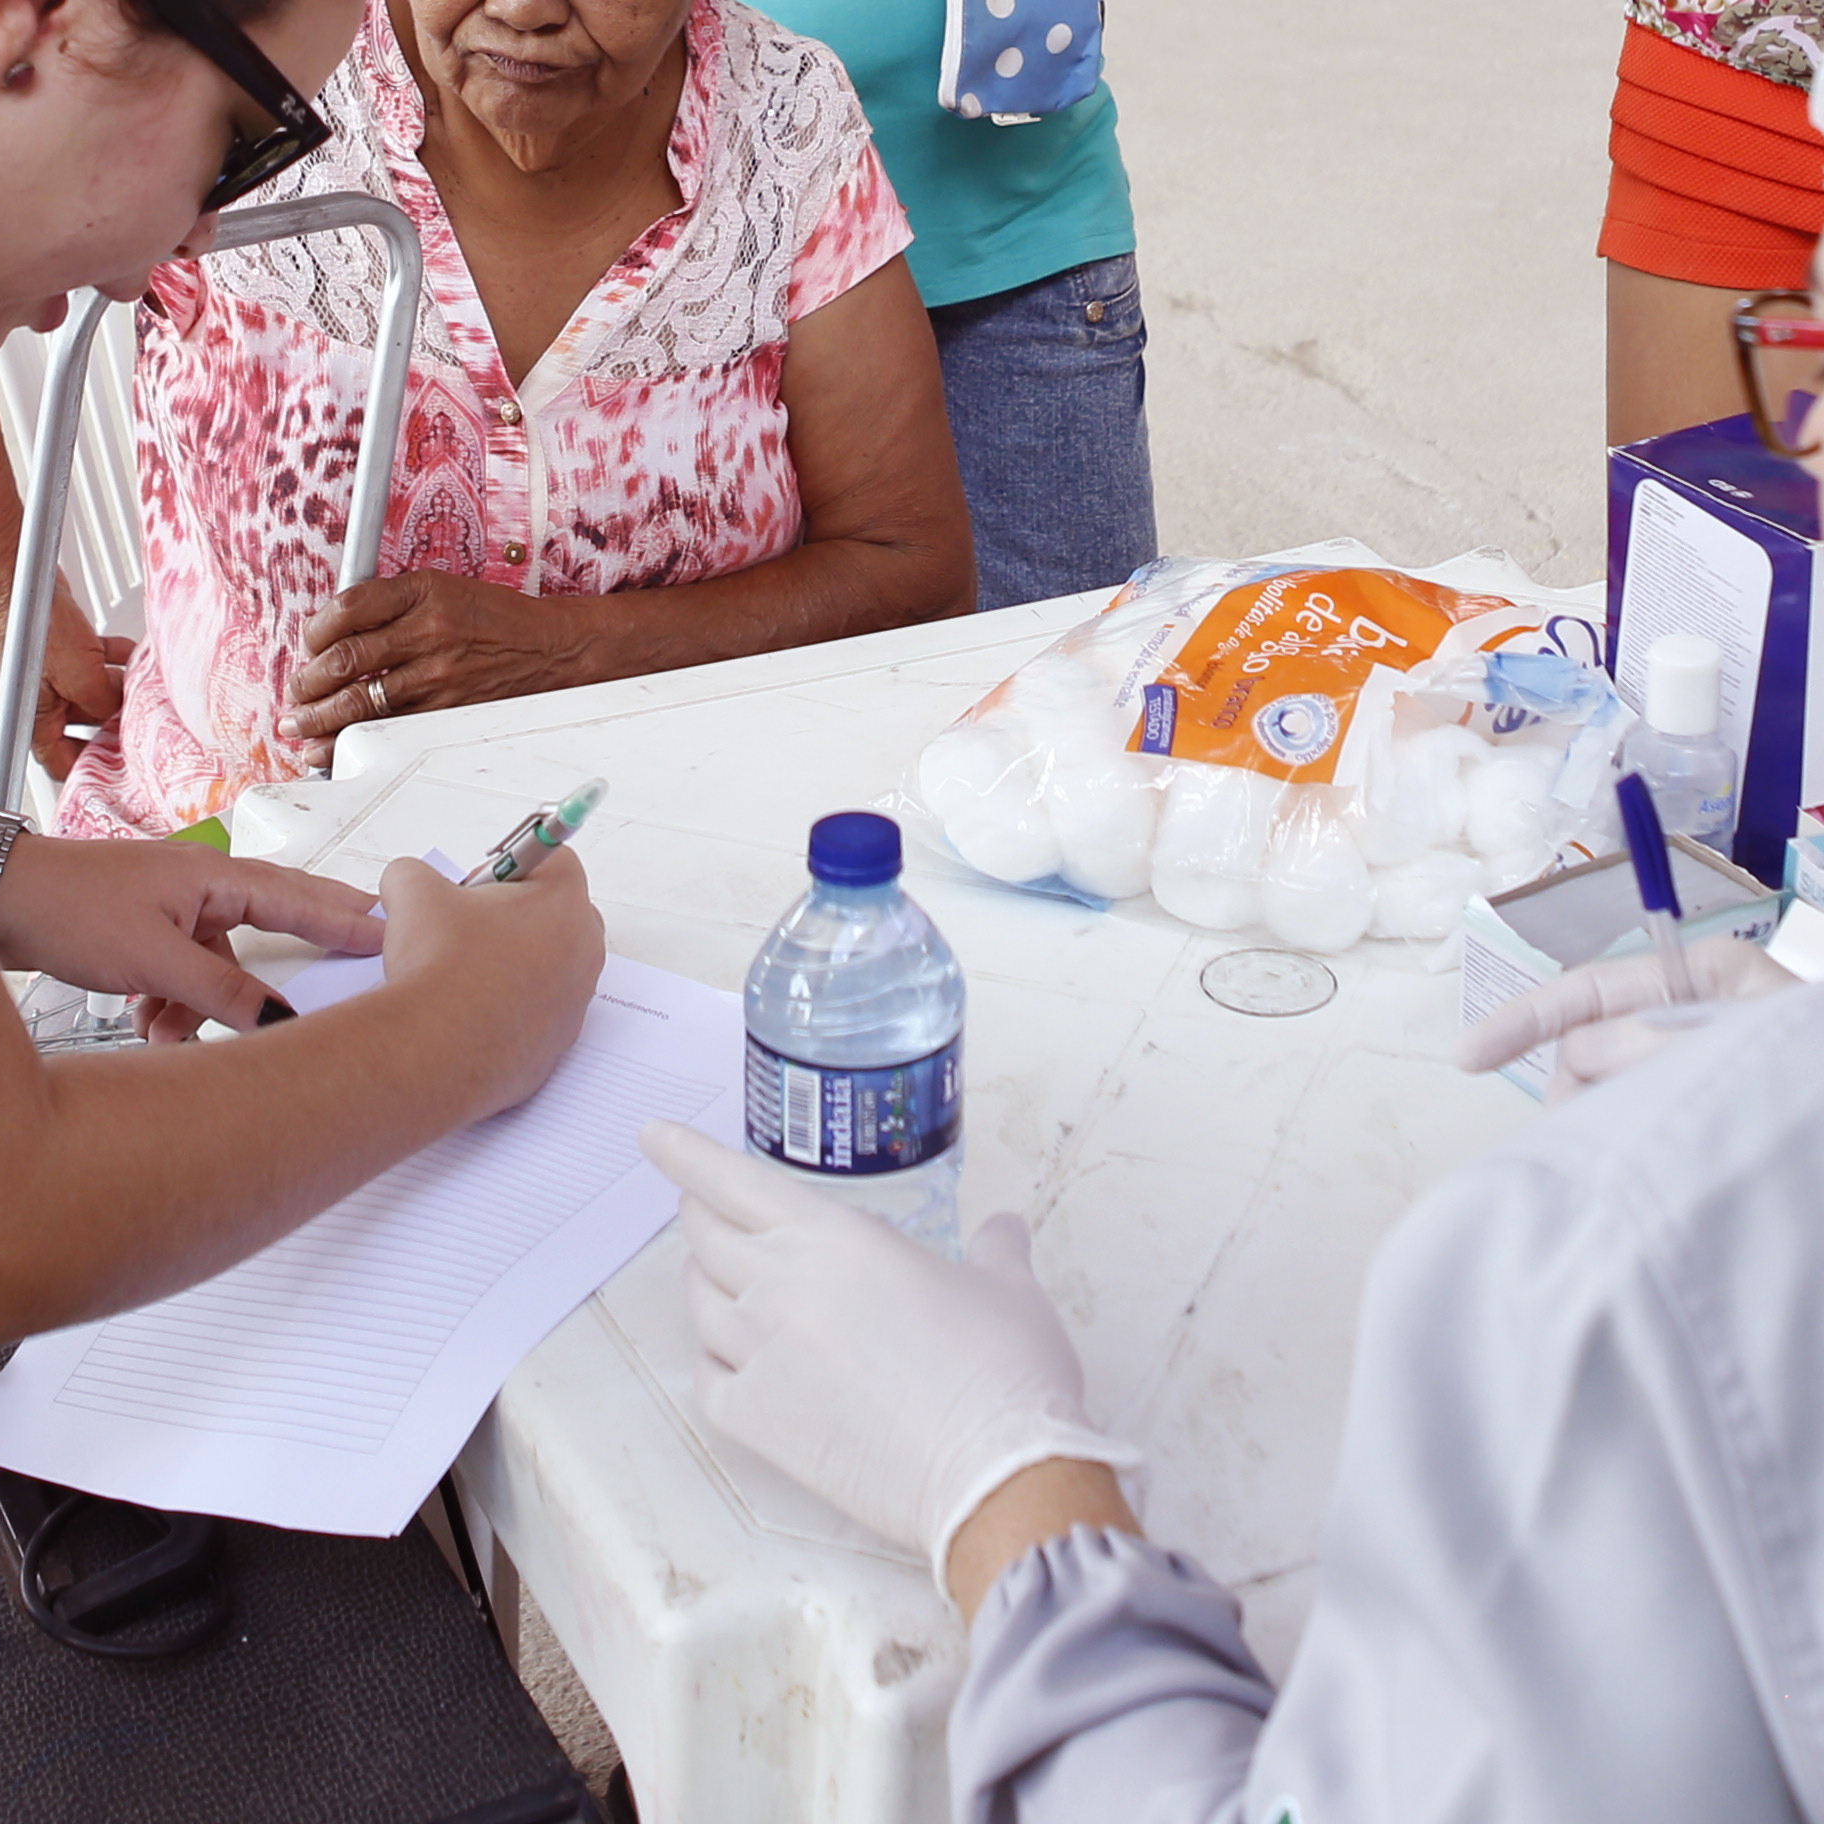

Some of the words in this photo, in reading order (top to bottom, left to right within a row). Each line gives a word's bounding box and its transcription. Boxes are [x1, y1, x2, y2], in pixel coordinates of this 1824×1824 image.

[1245, 577, 1297, 627] bolitas
[1295, 591, 1343, 633] de
[1146, 696, 1162, 741] TESTADO
[1211, 675, 1266, 730] branco
[598, 992, 670, 1020] Atendimento
[824, 1075, 853, 1169] indaiá
